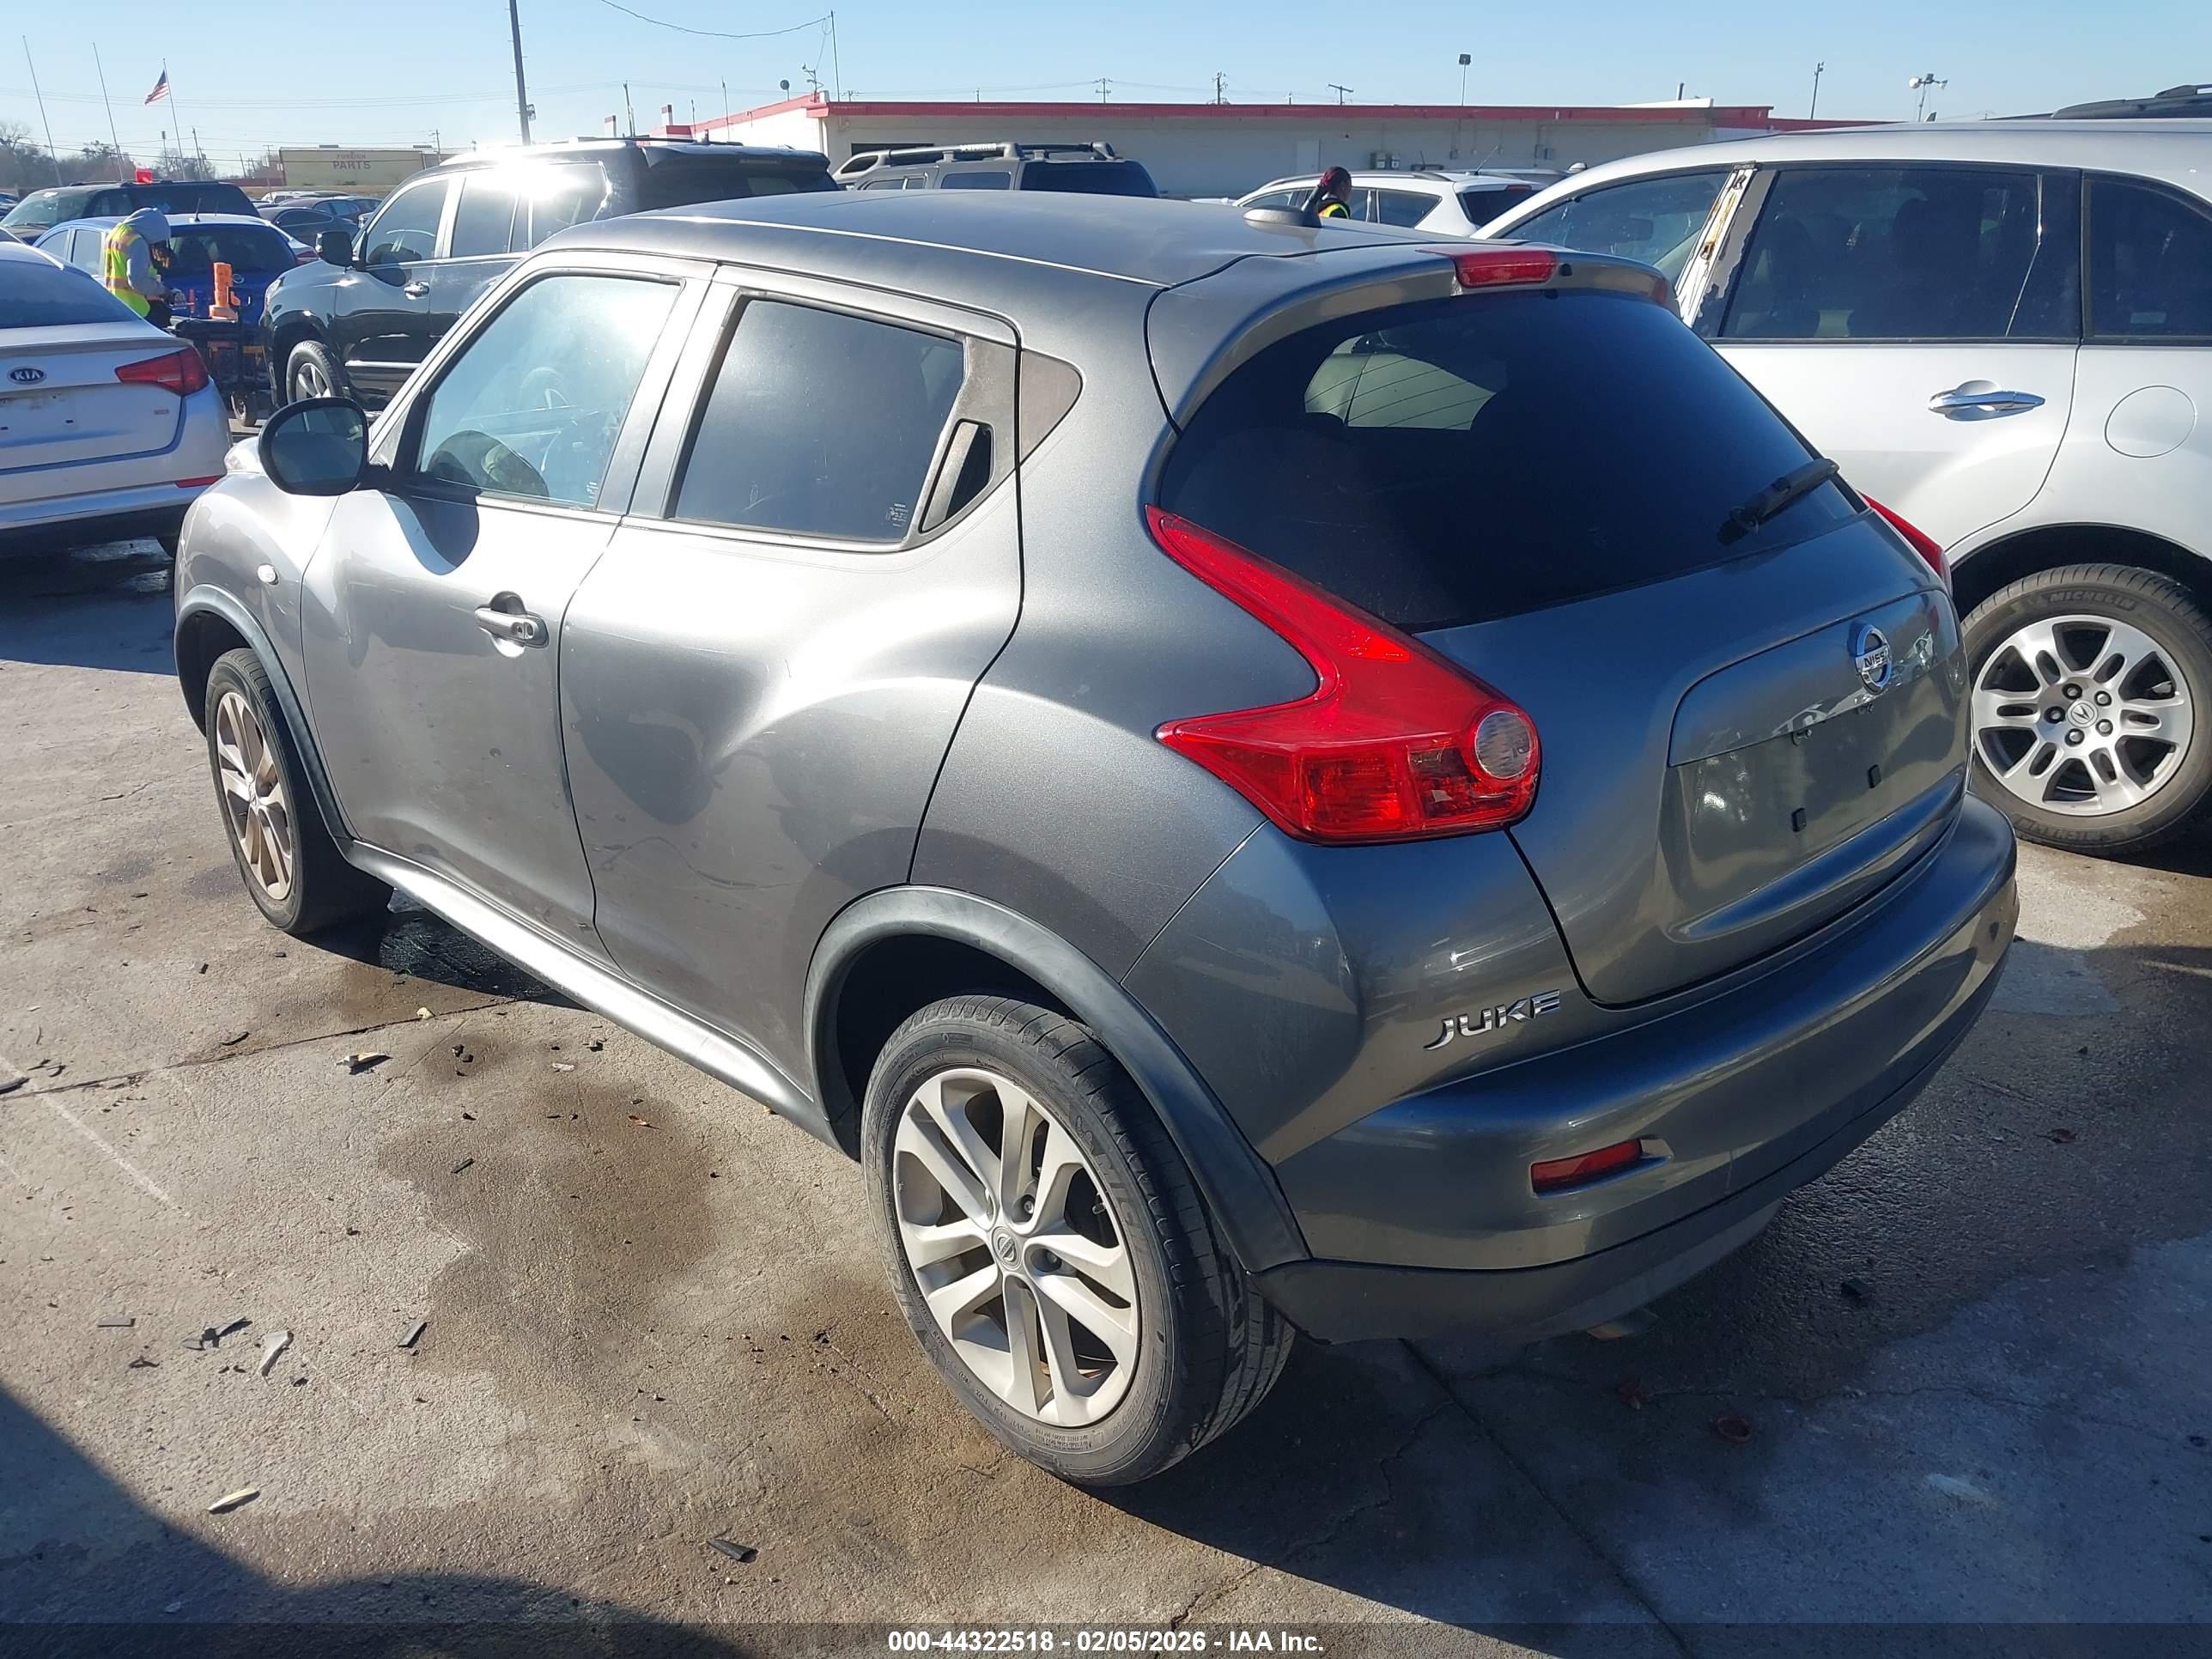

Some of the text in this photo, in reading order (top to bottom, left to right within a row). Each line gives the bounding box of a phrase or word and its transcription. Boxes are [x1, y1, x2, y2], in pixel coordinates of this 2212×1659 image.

[333, 160, 372, 170] PARTS
[15, 369, 41, 381] KIA
[2048, 592, 2137, 612] MICHELIN
[1423, 989, 1560, 1050] JUKE
